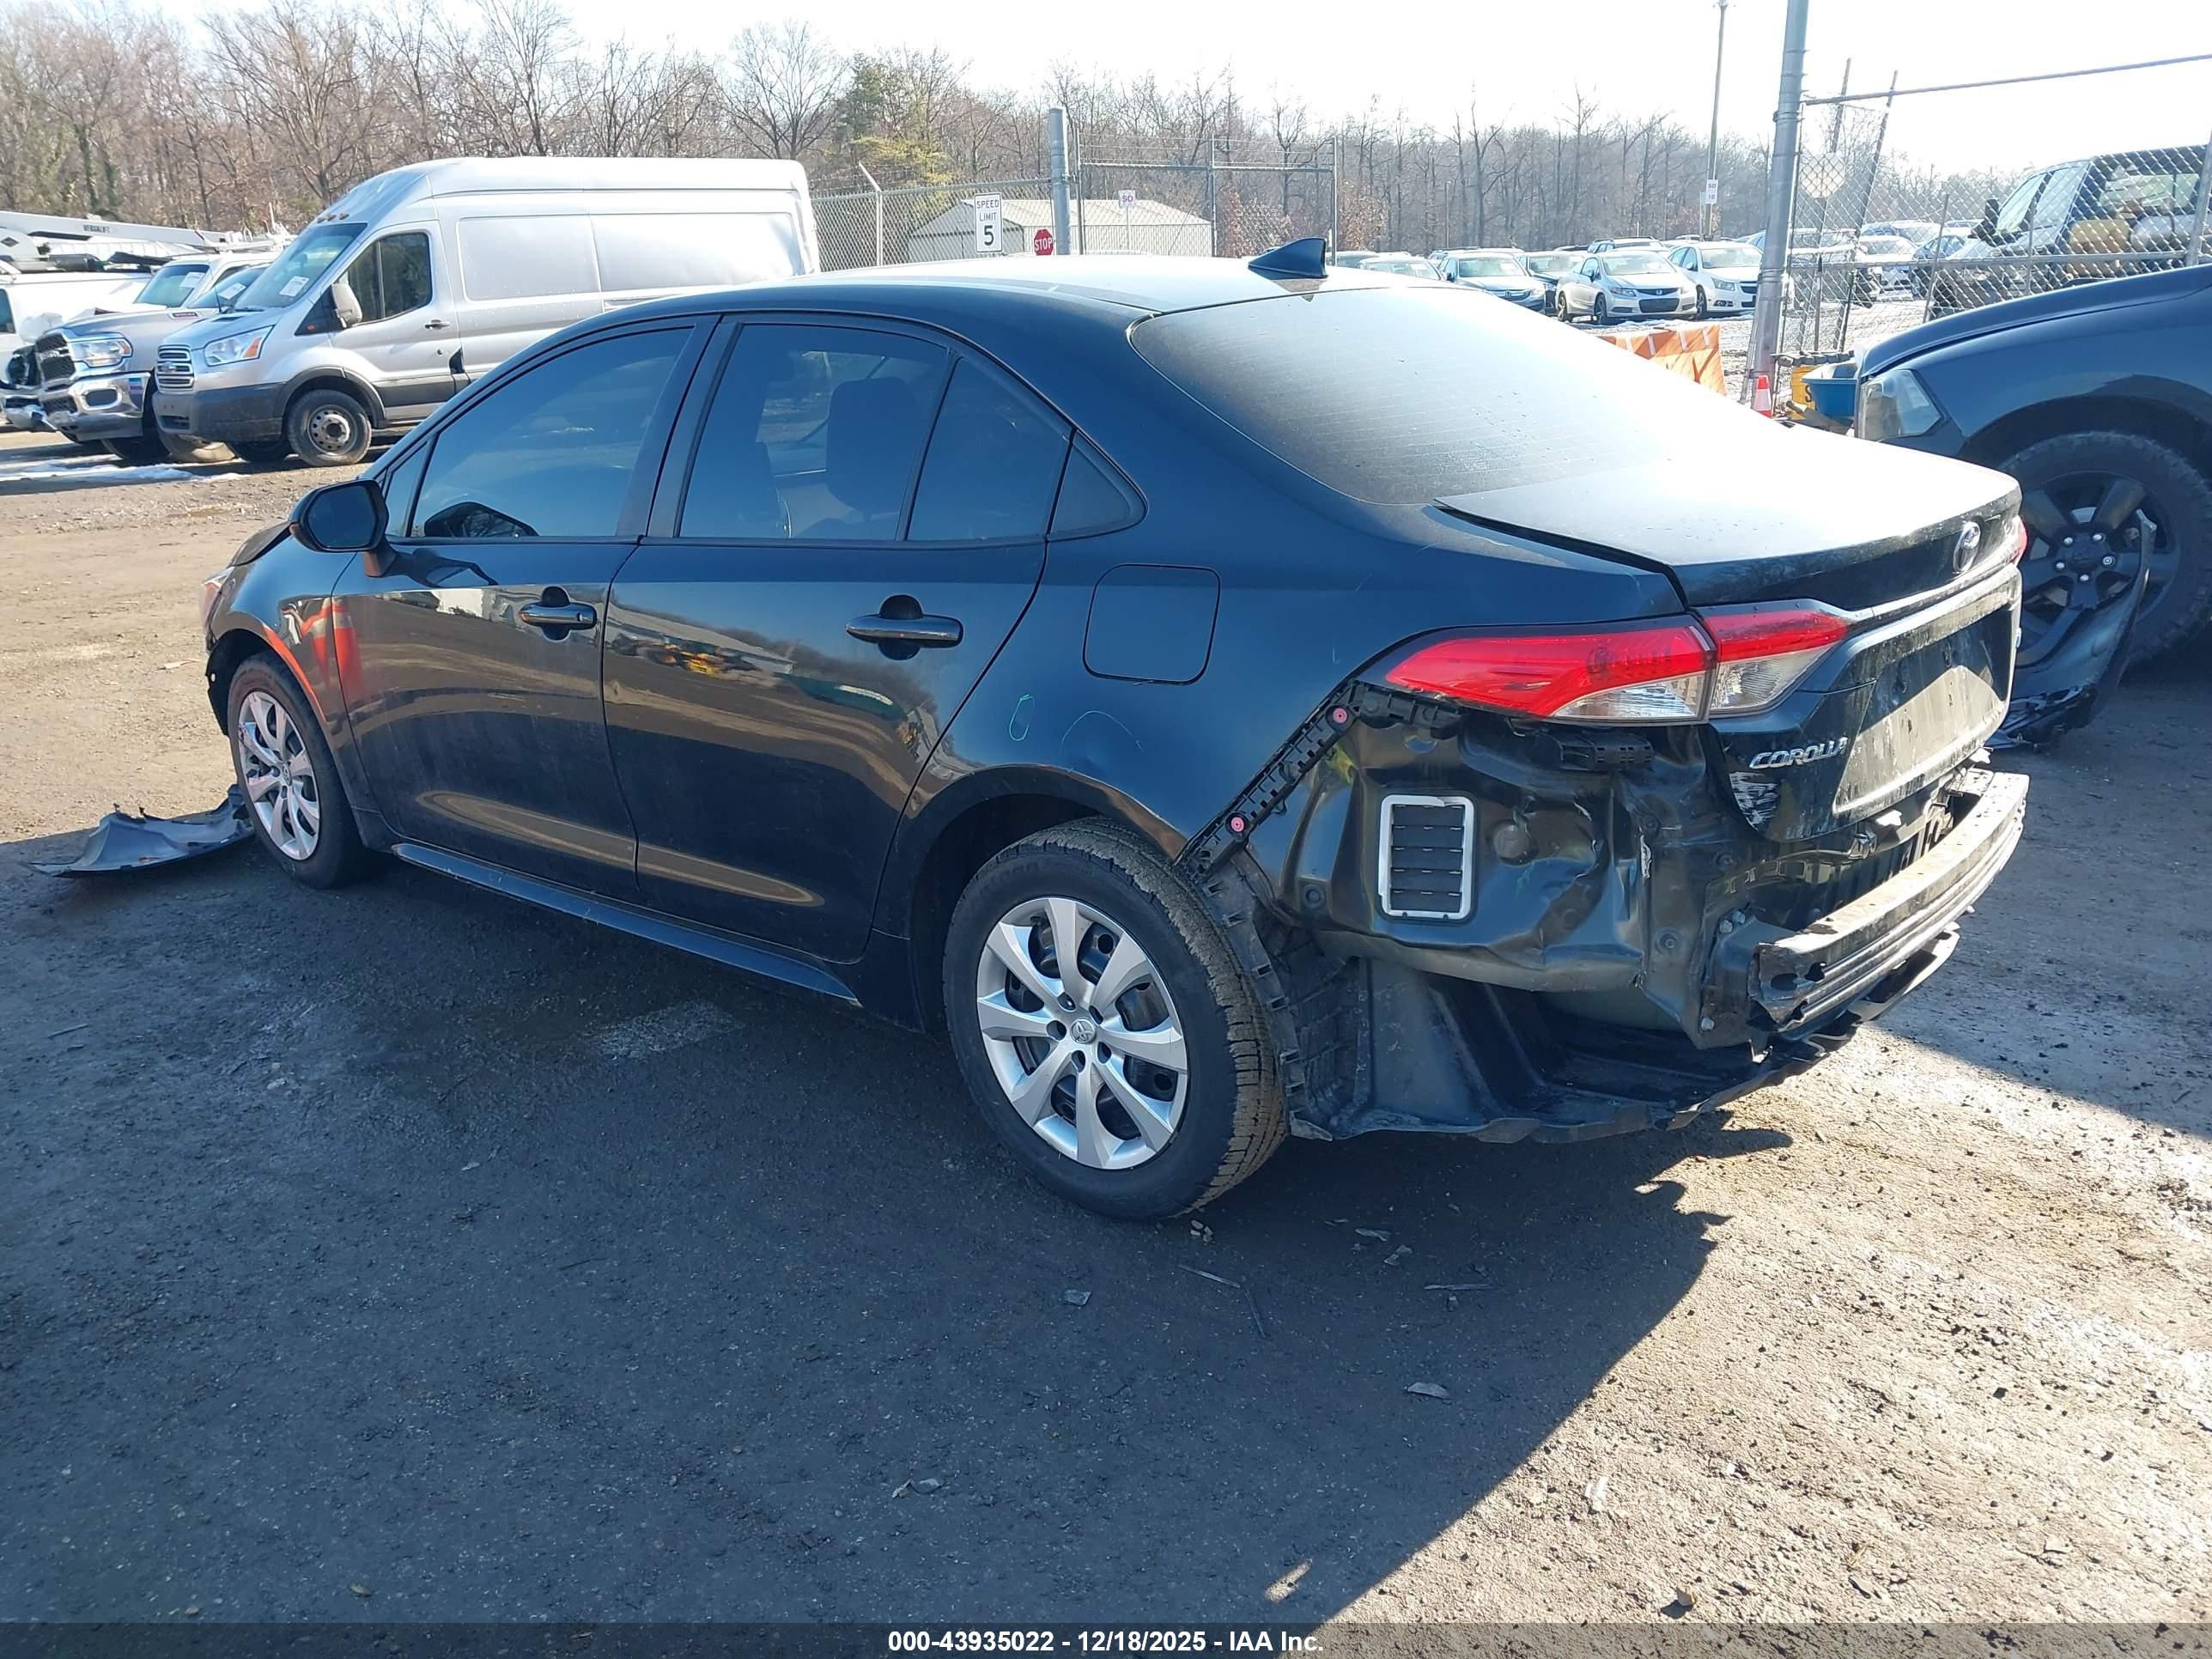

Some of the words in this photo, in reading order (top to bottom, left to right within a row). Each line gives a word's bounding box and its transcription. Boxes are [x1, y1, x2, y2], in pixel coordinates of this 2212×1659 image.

[976, 198, 1000, 210] SPEED
[979, 212, 997, 222] LIMIT
[984, 224, 994, 246] 5
[1034, 237, 1053, 252] STOP
[1749, 737, 1848, 769] COROLLA
